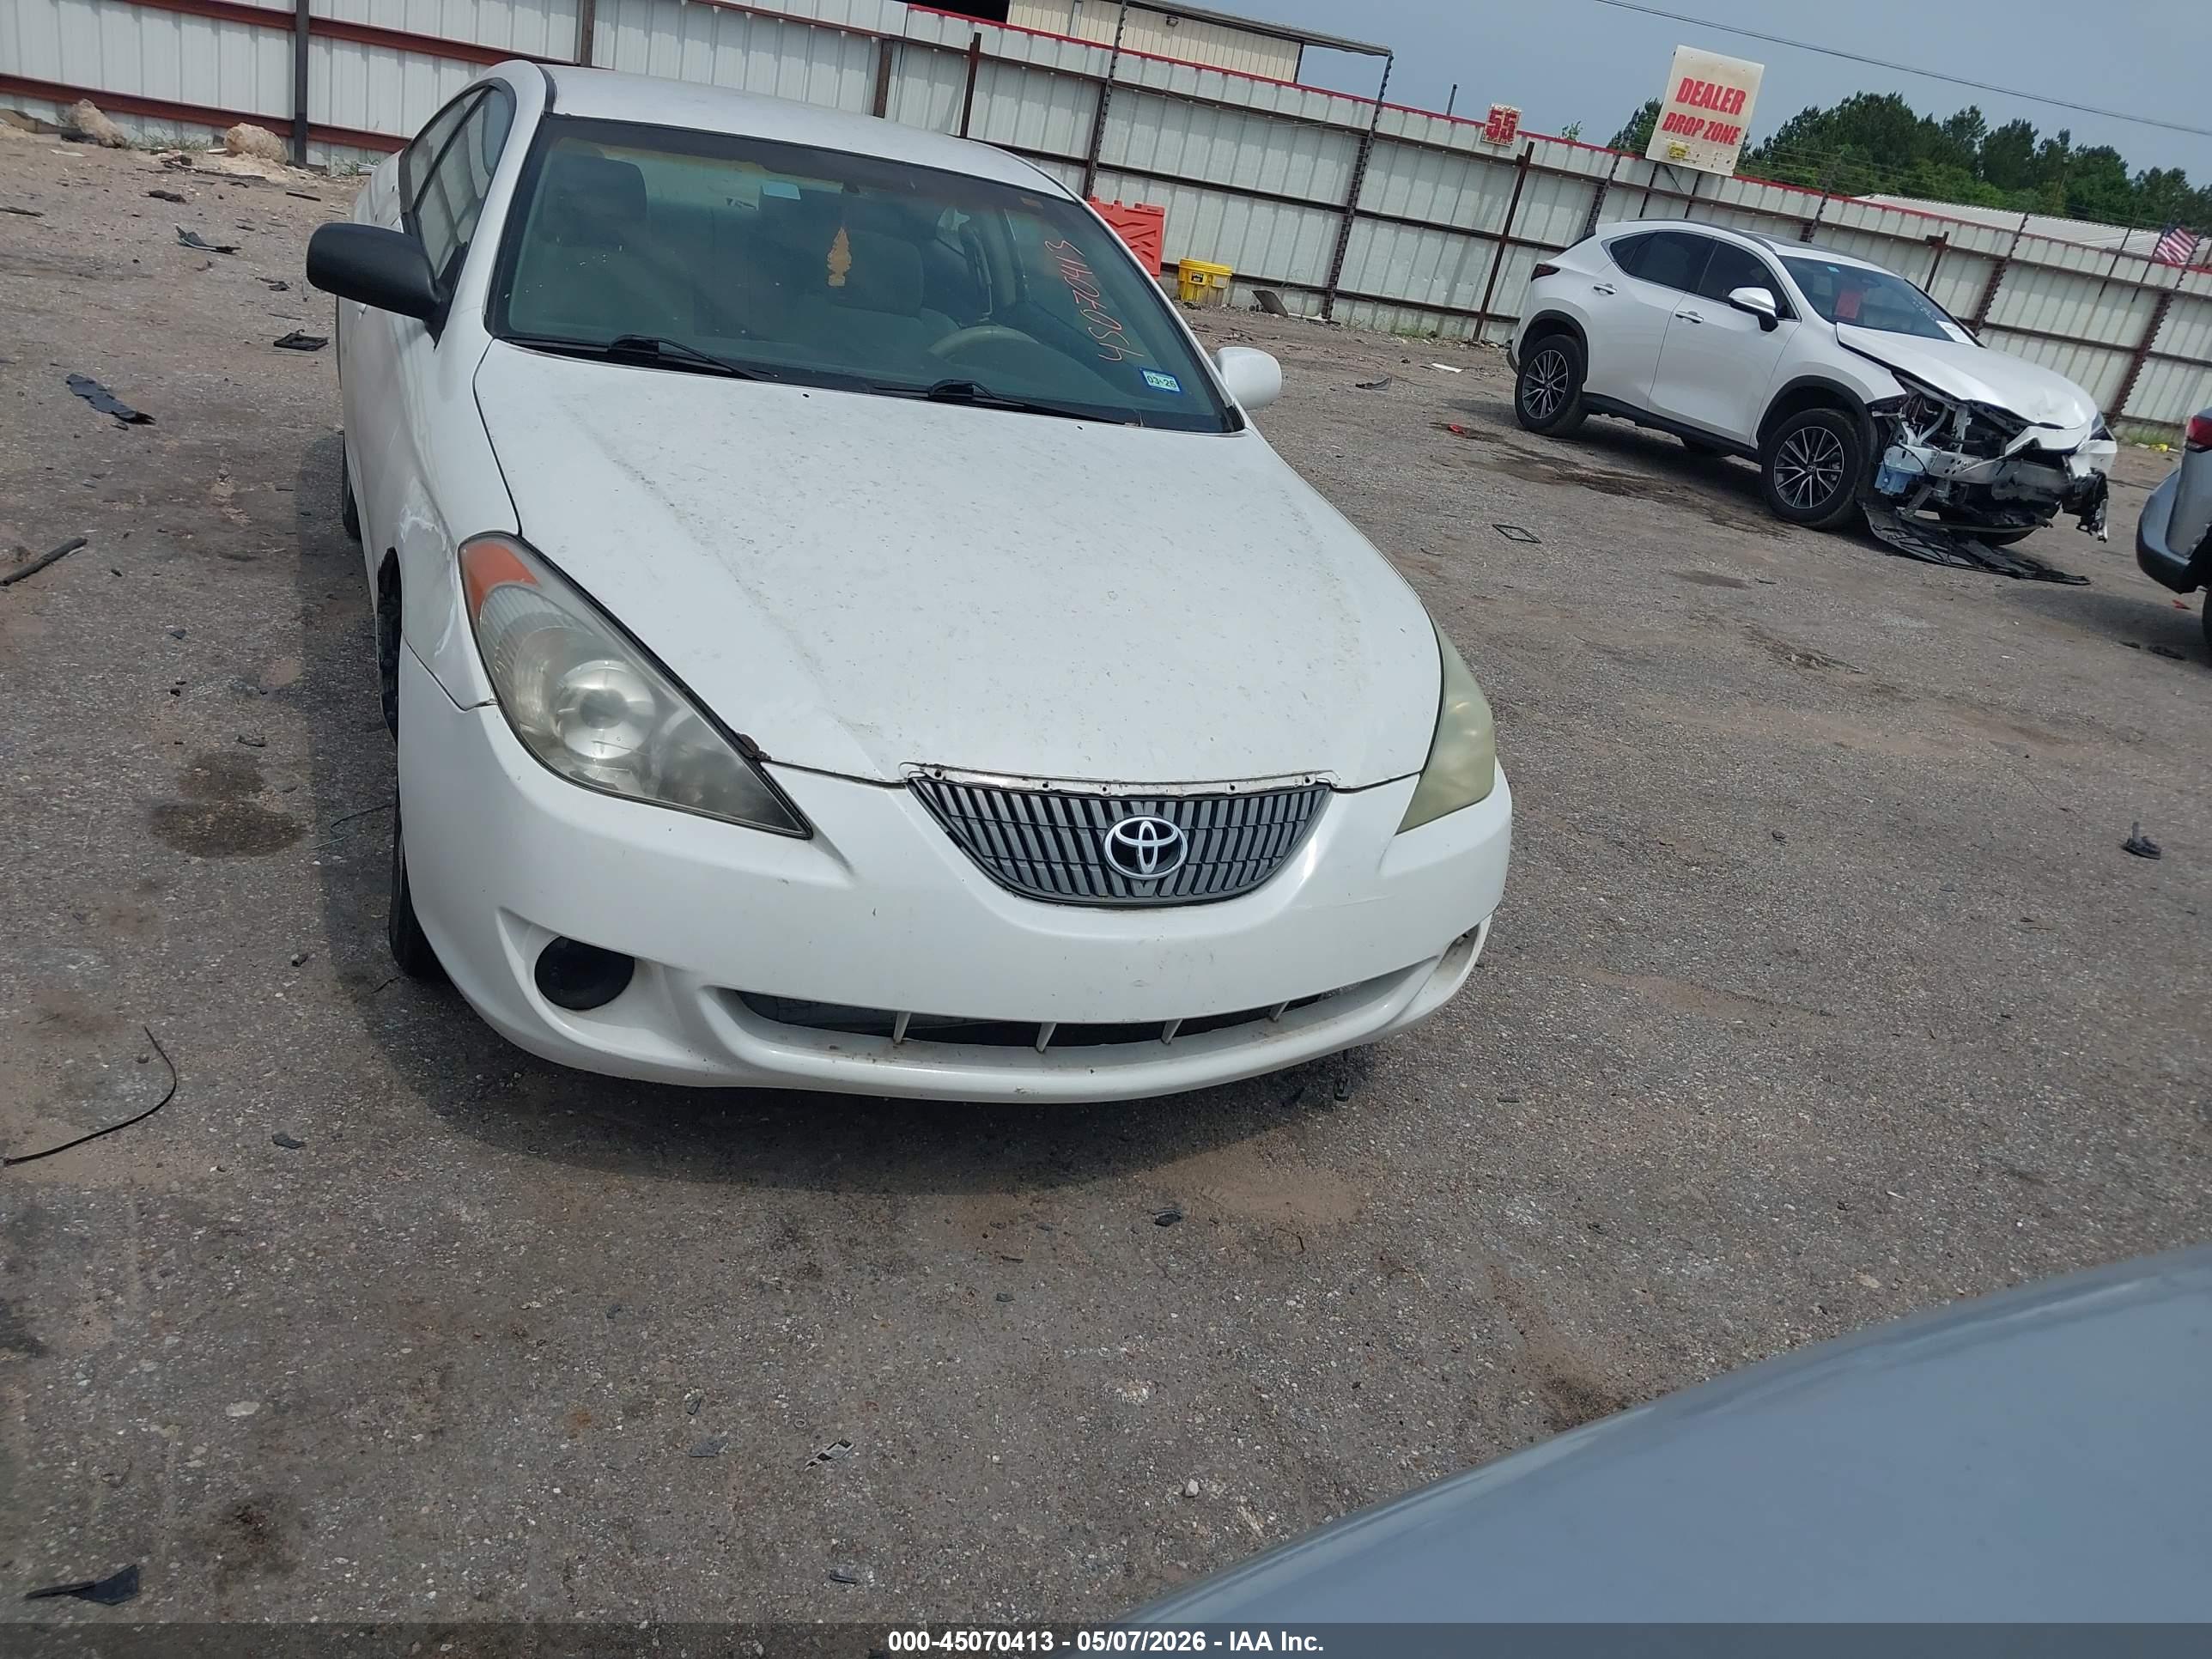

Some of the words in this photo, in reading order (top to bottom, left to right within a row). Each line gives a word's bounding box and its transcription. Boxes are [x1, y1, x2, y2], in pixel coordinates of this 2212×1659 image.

[1675, 77, 1747, 116] DEALER
[1486, 109, 1517, 141] 55
[1662, 112, 1705, 138] DROP
[1702, 122, 1741, 146] ZONE
[1044, 240, 1145, 362] 45070413
